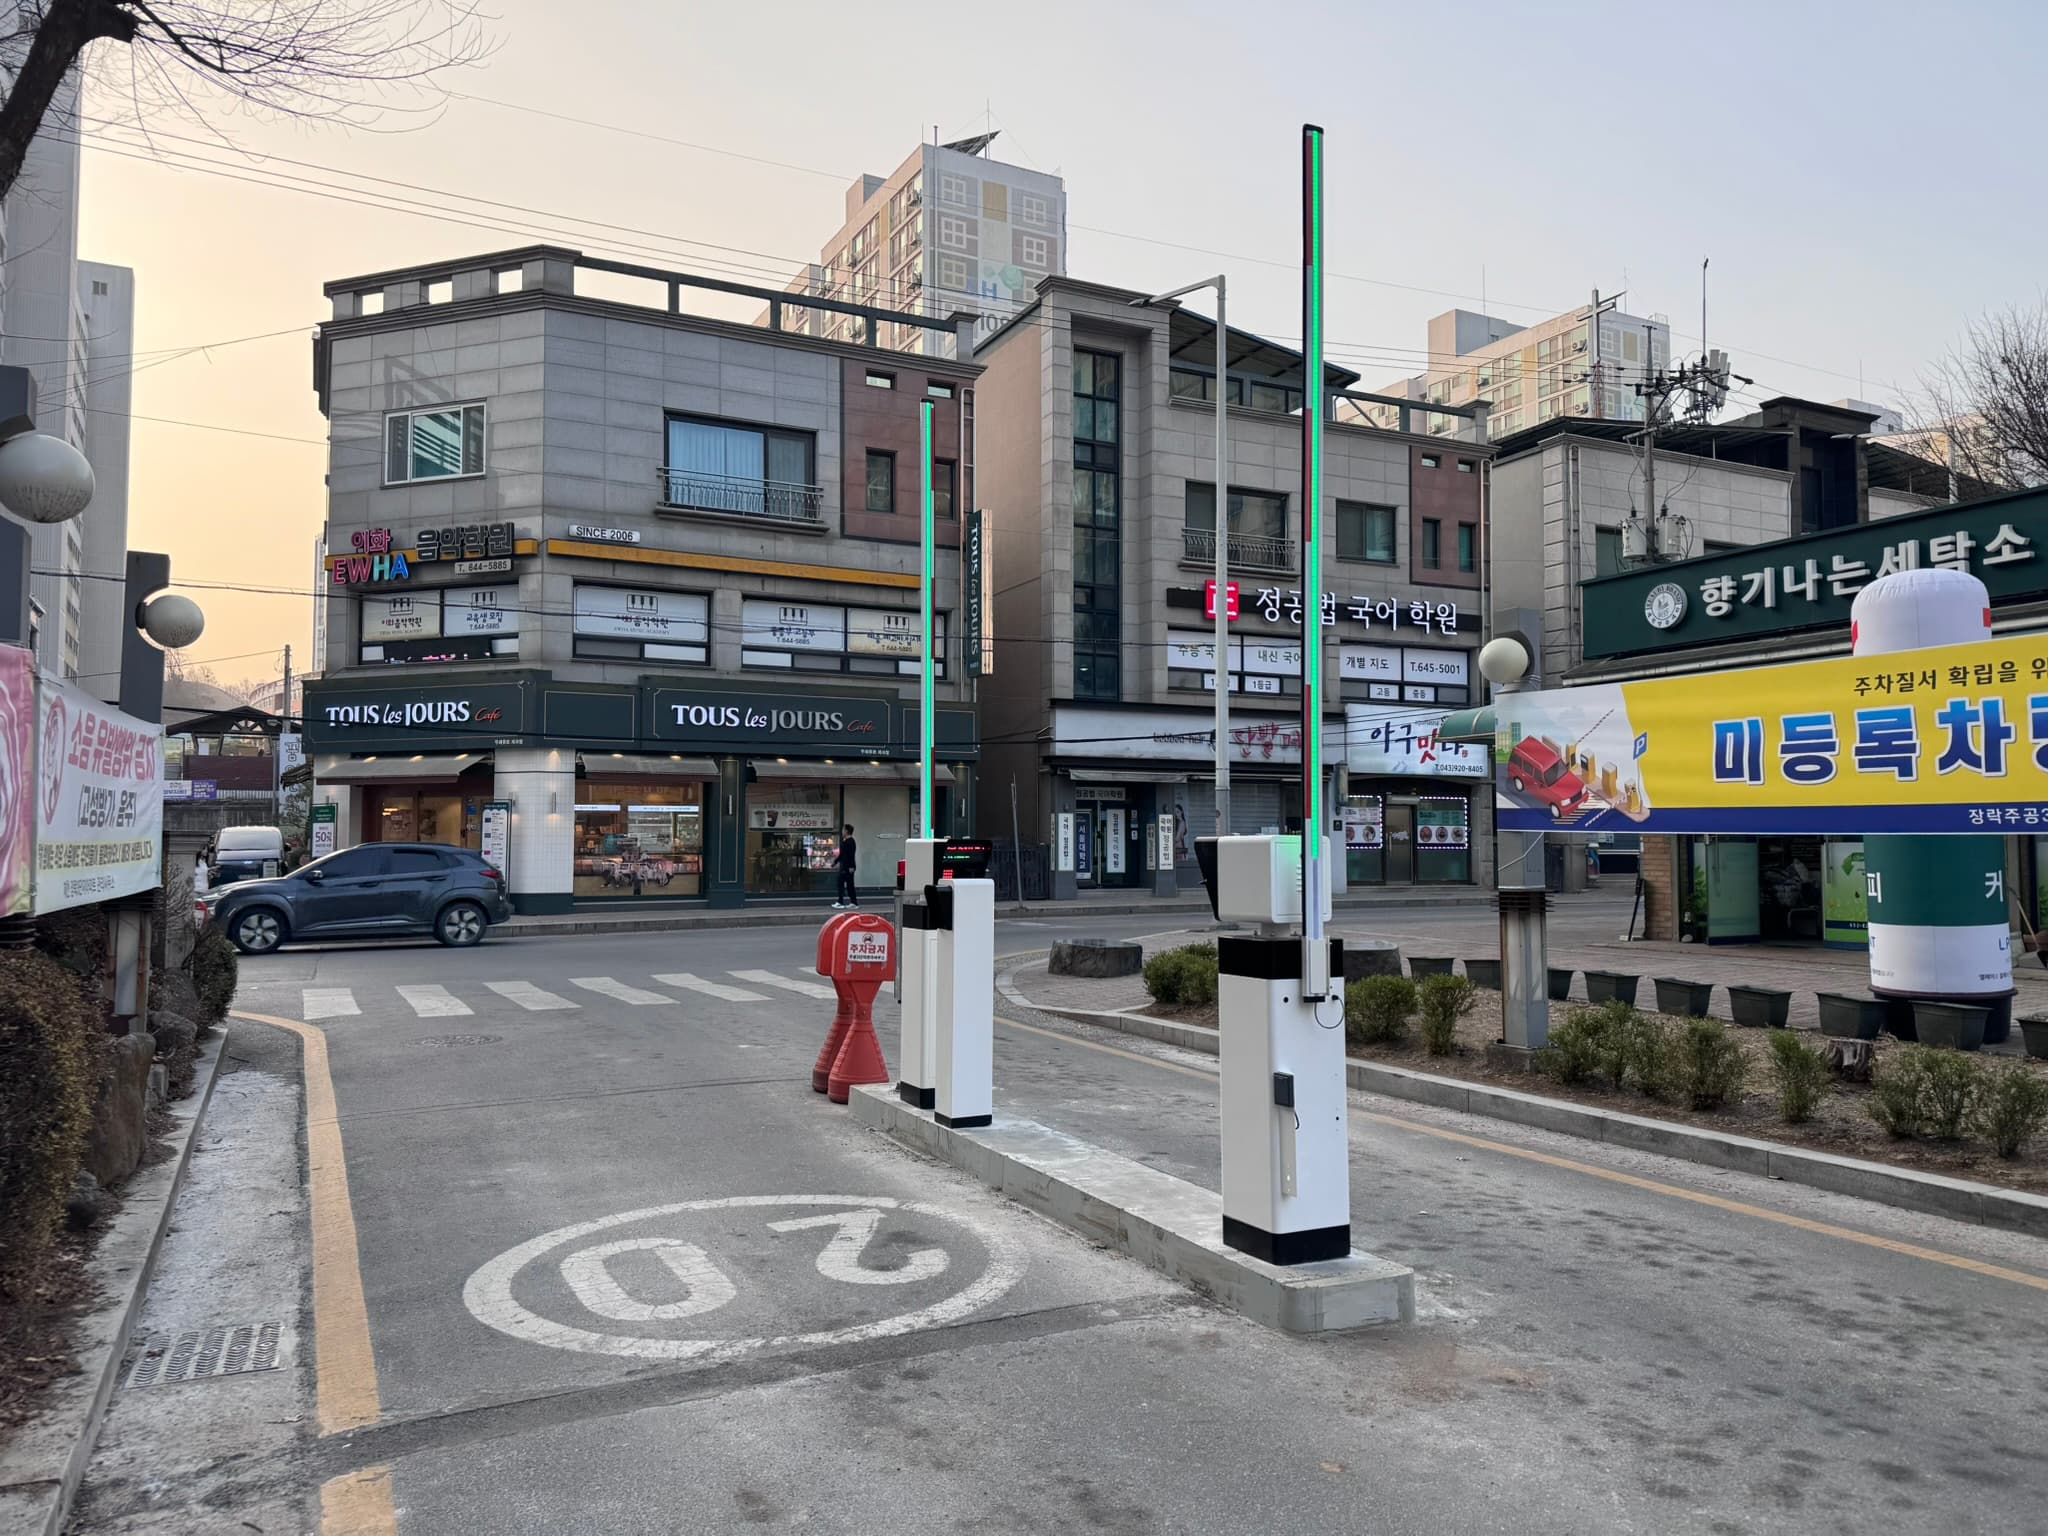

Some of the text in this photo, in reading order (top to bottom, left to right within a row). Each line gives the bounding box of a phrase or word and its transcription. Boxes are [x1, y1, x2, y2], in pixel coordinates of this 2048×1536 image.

[352, 521, 514, 561] 이화 음악학원
[576, 527, 634, 541] SINCE 2006
[970, 523, 979, 576] TOUS
[332, 553, 409, 584] EWHA
[466, 611, 503, 623] 교육생 모집
[969, 597, 979, 656] JOURS
[1347, 596, 1398, 632] 국어
[1409, 599, 1458, 636] 학원
[1258, 649, 1278, 664] 내신
[1346, 655, 1390, 670] 개별 지도
[1409, 661, 1461, 676] T.645-5001
[1252, 679, 1272, 691] 1등급
[1854, 670, 1937, 696] 주차질서
[1948, 660, 2019, 687] 확립을
[326, 704, 380, 727] TOUS
[382, 703, 402, 724] les
[404, 701, 470, 726] JOURS
[671, 704, 740, 728] TOUS
[744, 708, 767, 729] les
[769, 709, 843, 733] JOURS
[68, 708, 96, 770] 소음
[134, 733, 156, 781] 금지
[1985, 870, 2004, 903] 커
